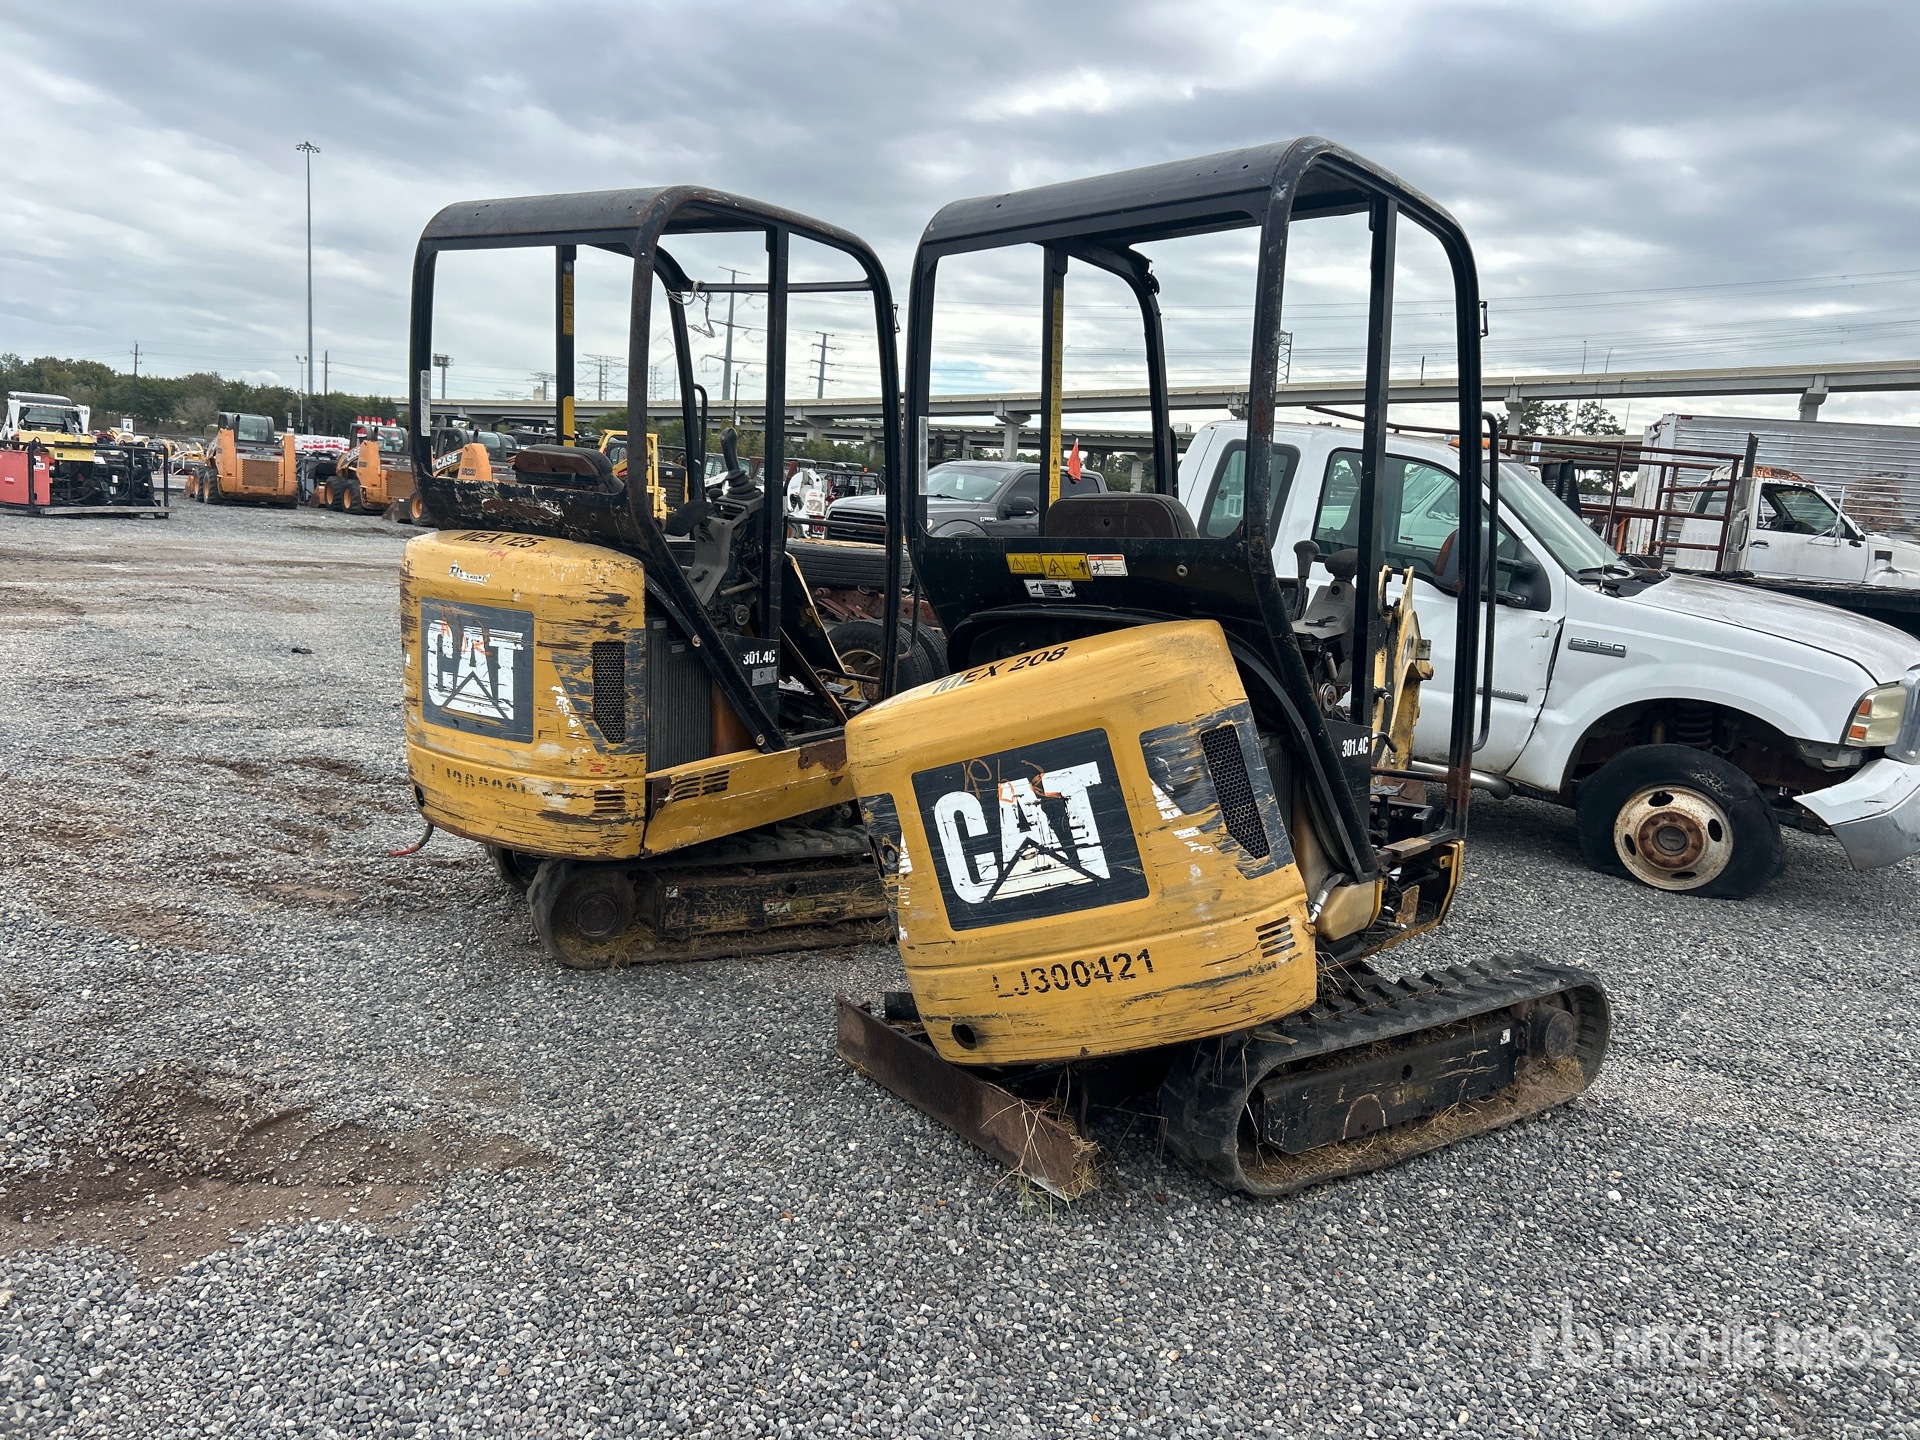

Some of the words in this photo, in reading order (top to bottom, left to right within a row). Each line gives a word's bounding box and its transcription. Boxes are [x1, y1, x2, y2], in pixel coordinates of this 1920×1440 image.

[436, 453, 458, 469] CASE
[453, 531, 510, 543] MEX
[502, 535, 546, 548] 125
[427, 619, 524, 720] CAT
[742, 649, 776, 665] 301.4C
[932, 661, 1007, 694] MEX
[1007, 646, 1069, 672] 208
[1341, 736, 1369, 758] 301.4C
[934, 760, 1103, 904] CAT
[991, 948, 1155, 999] LJ300421
